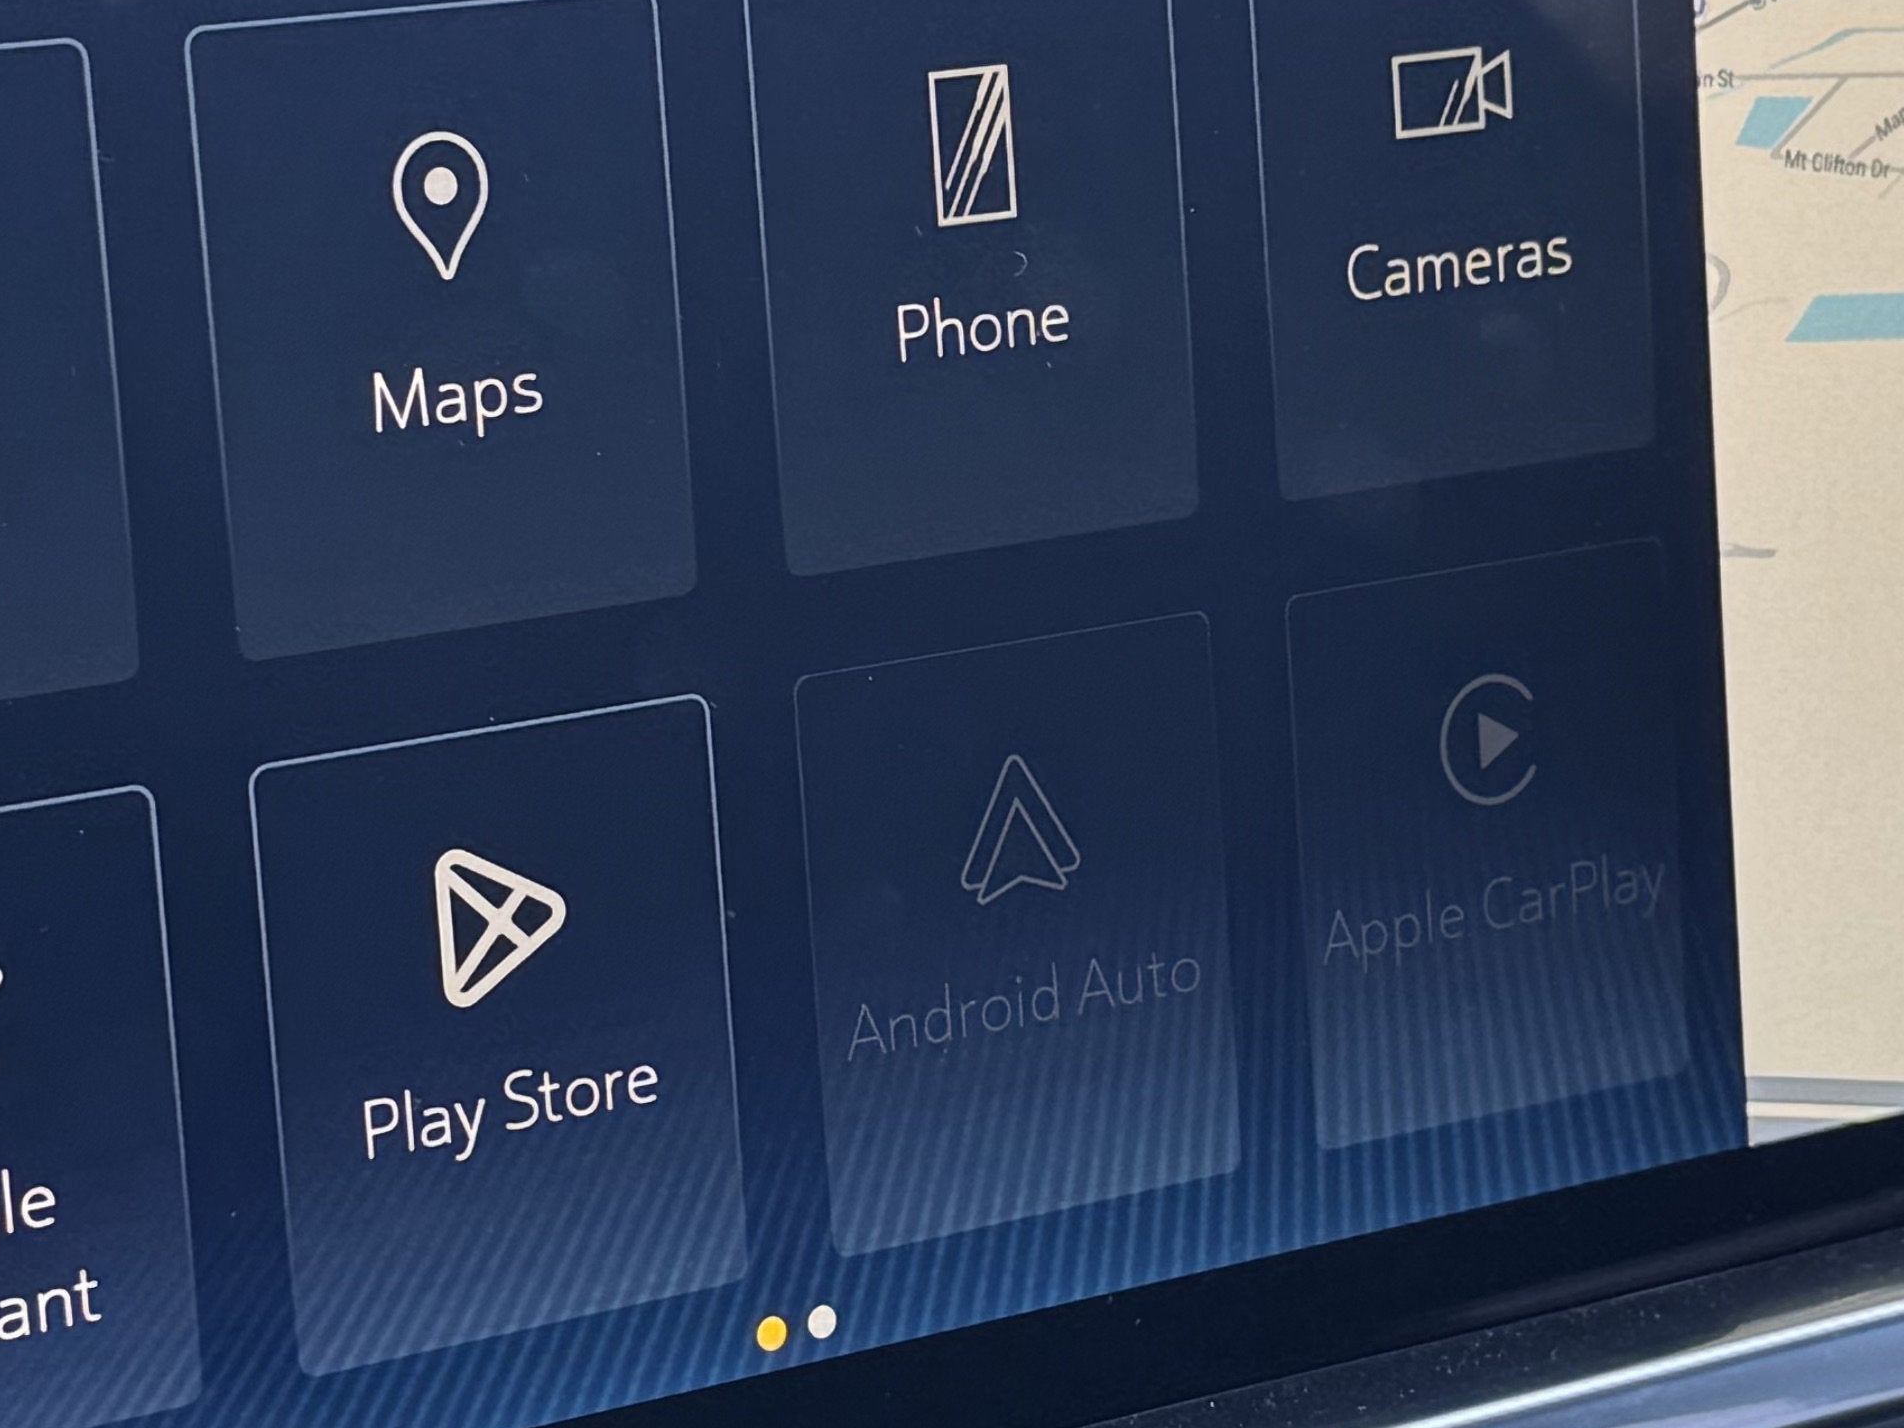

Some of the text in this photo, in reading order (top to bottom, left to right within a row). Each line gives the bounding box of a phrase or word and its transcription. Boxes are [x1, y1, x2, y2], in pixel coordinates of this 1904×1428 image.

[1718, 68, 1734, 89] St
[1784, 149, 1891, 179] Mt Clifton Dr
[1346, 235, 1574, 302] Cameras
[896, 297, 1071, 363] Phone
[371, 367, 545, 438] Maps
[1322, 855, 1667, 974] Apple CarPlay
[846, 951, 1202, 1062] Android Auto
[362, 1062, 659, 1162] Play Store
